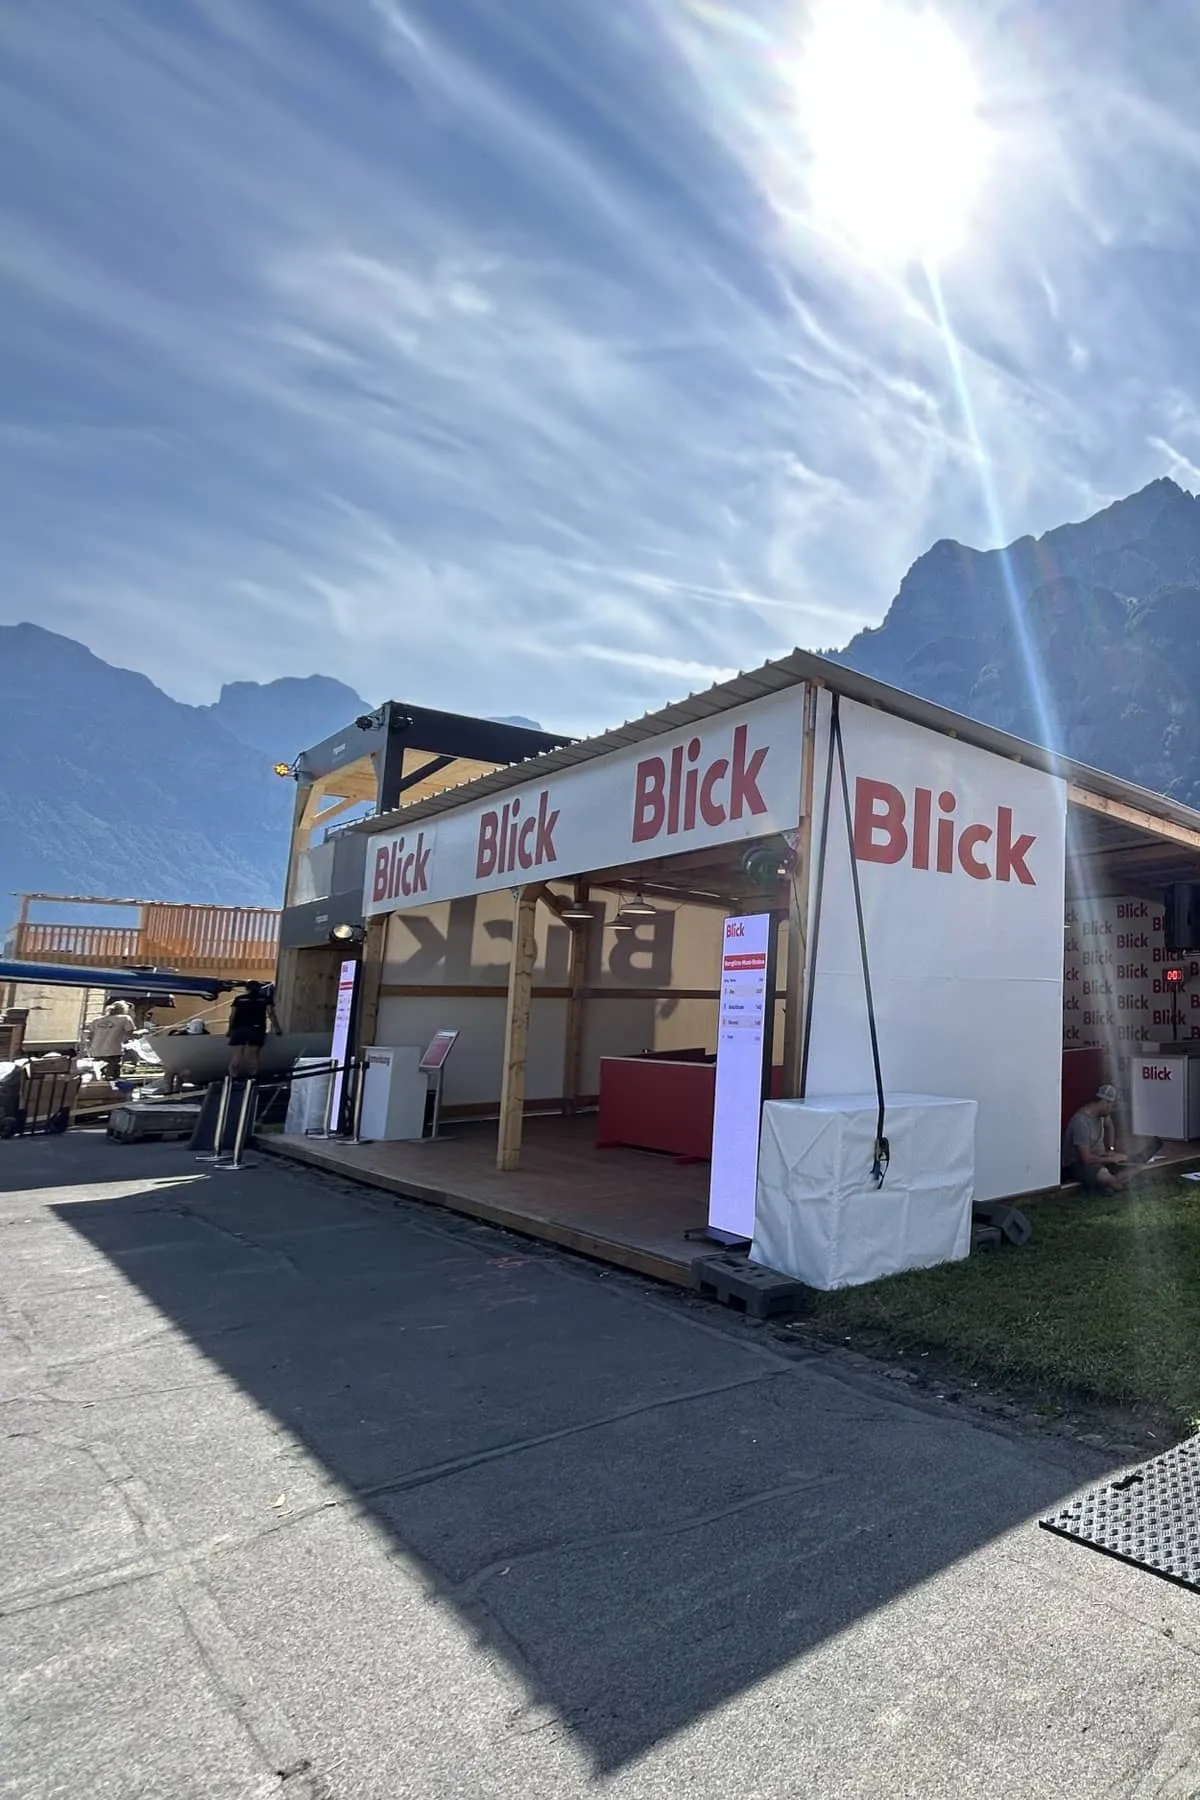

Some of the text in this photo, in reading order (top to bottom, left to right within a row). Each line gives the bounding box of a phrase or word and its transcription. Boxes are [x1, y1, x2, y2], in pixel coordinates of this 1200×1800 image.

[632, 724, 770, 843] Blick
[475, 791, 561, 880] Blick
[854, 776, 1037, 886] Blick
[372, 832, 432, 902] Blick
[1117, 902, 1148, 918] Blick
[726, 922, 745, 938] Blick
[1083, 921, 1112, 935] Blick
[1117, 933, 1149, 949] Blick
[1083, 950, 1112, 965] Blick
[1117, 963, 1148, 979] Blick
[1083, 980, 1112, 994] Blick
[1117, 994, 1149, 1010] Blick
[1083, 1011, 1114, 1025] Blick
[1153, 1010, 1186, 1025] Blick
[1118, 1025, 1149, 1040] Blick
[1142, 1066, 1172, 1080] Blick
